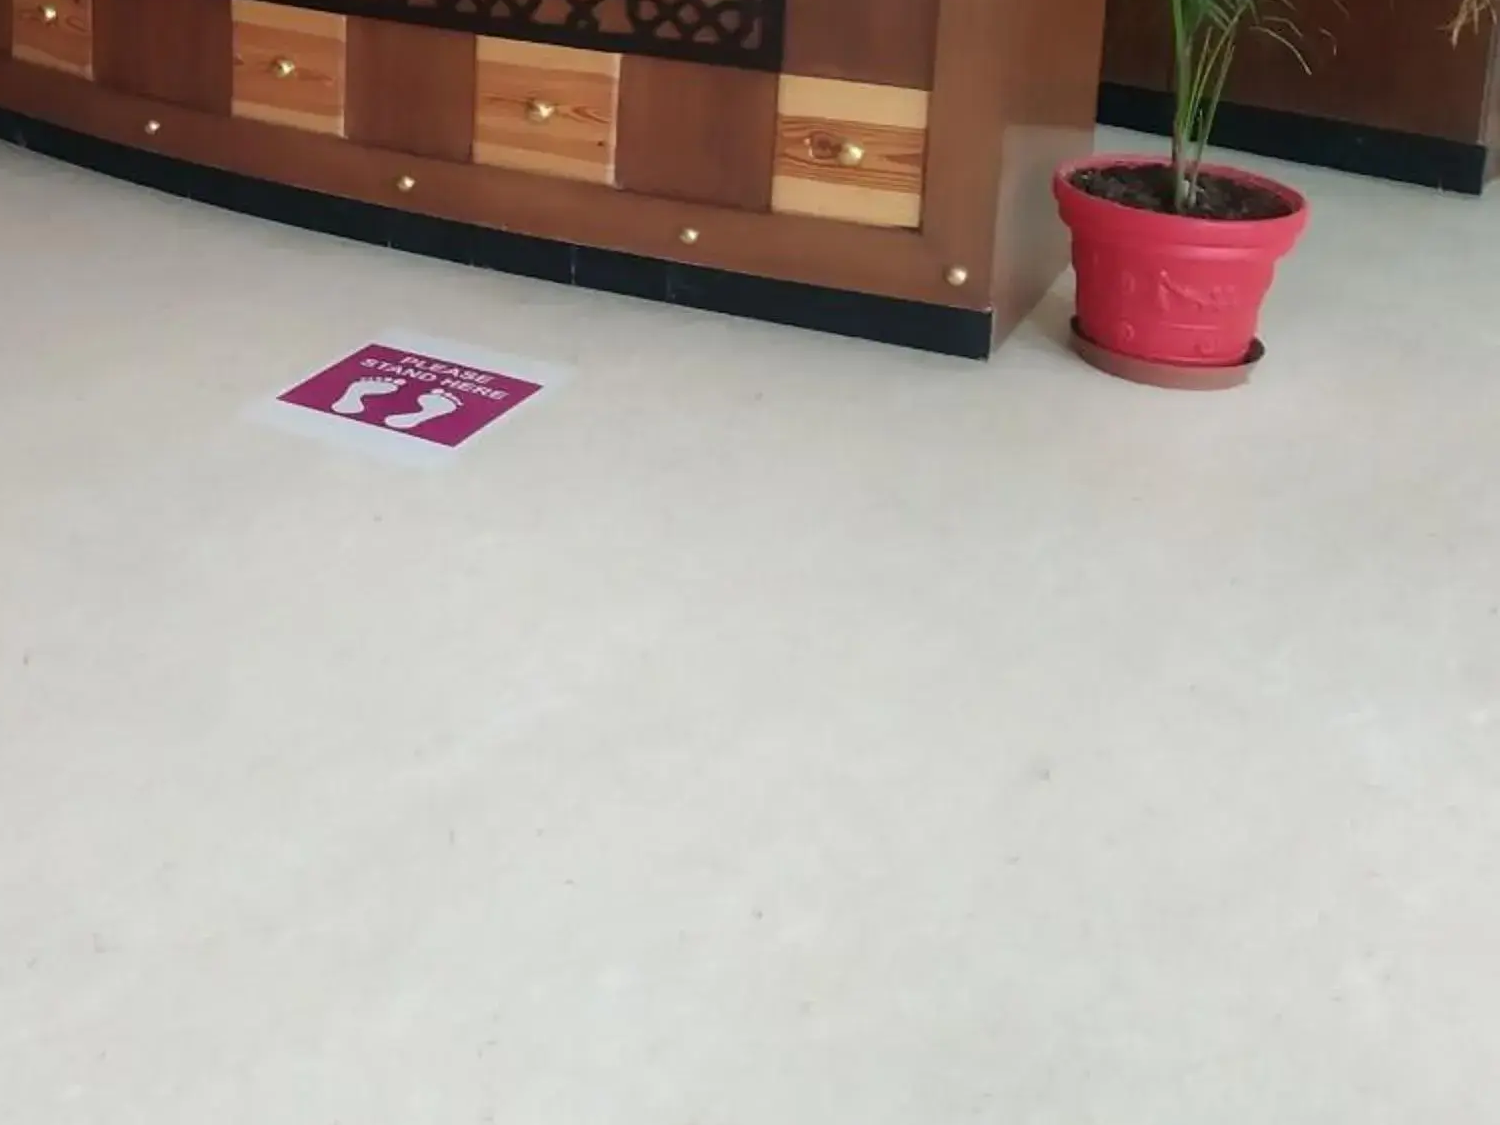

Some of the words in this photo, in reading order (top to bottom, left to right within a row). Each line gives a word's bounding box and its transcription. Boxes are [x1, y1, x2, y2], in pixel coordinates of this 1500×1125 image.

[360, 358, 437, 382] STAND
[440, 378, 509, 400] HERE
[401, 356, 494, 384] PLEASE
